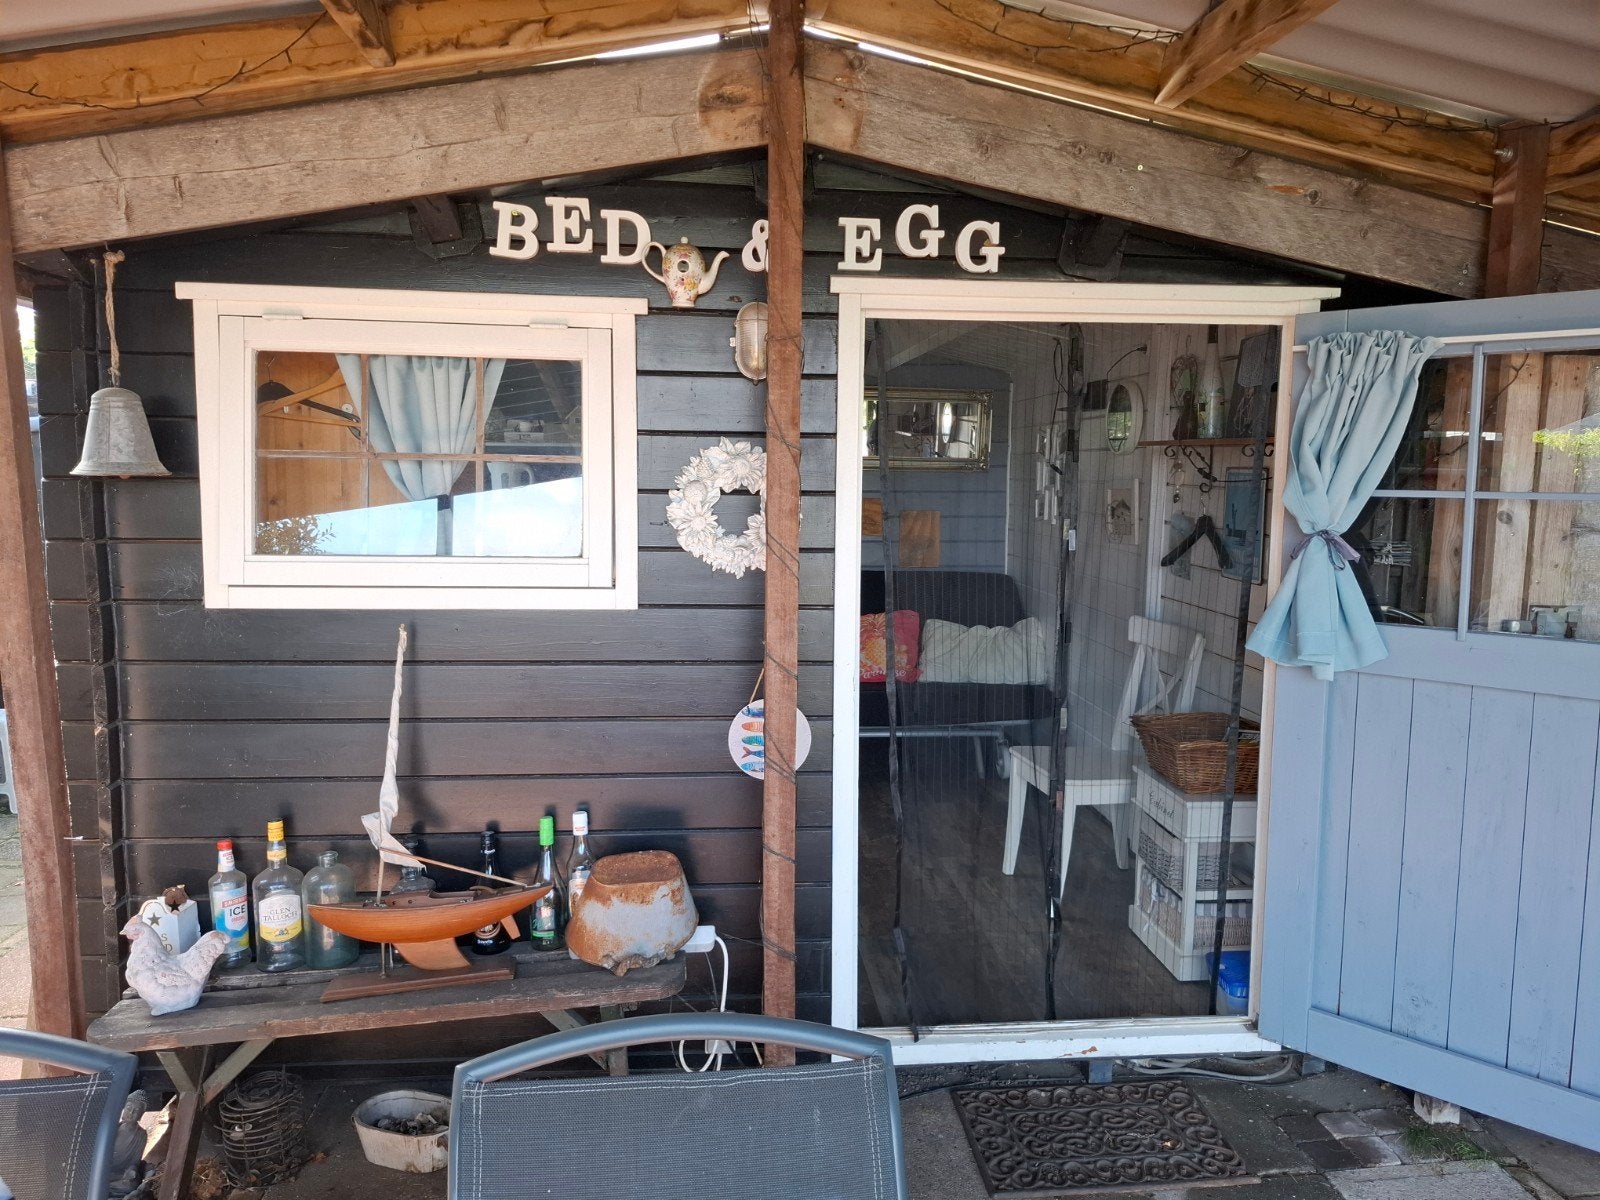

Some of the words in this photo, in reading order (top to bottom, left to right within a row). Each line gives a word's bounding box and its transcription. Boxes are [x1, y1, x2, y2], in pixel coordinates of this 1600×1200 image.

[489, 196, 651, 265] BED
[742, 219, 769, 272] &
[837, 204, 1006, 274] EGG
[229, 903, 246, 917] ICE
[269, 906, 291, 915] GLEN
